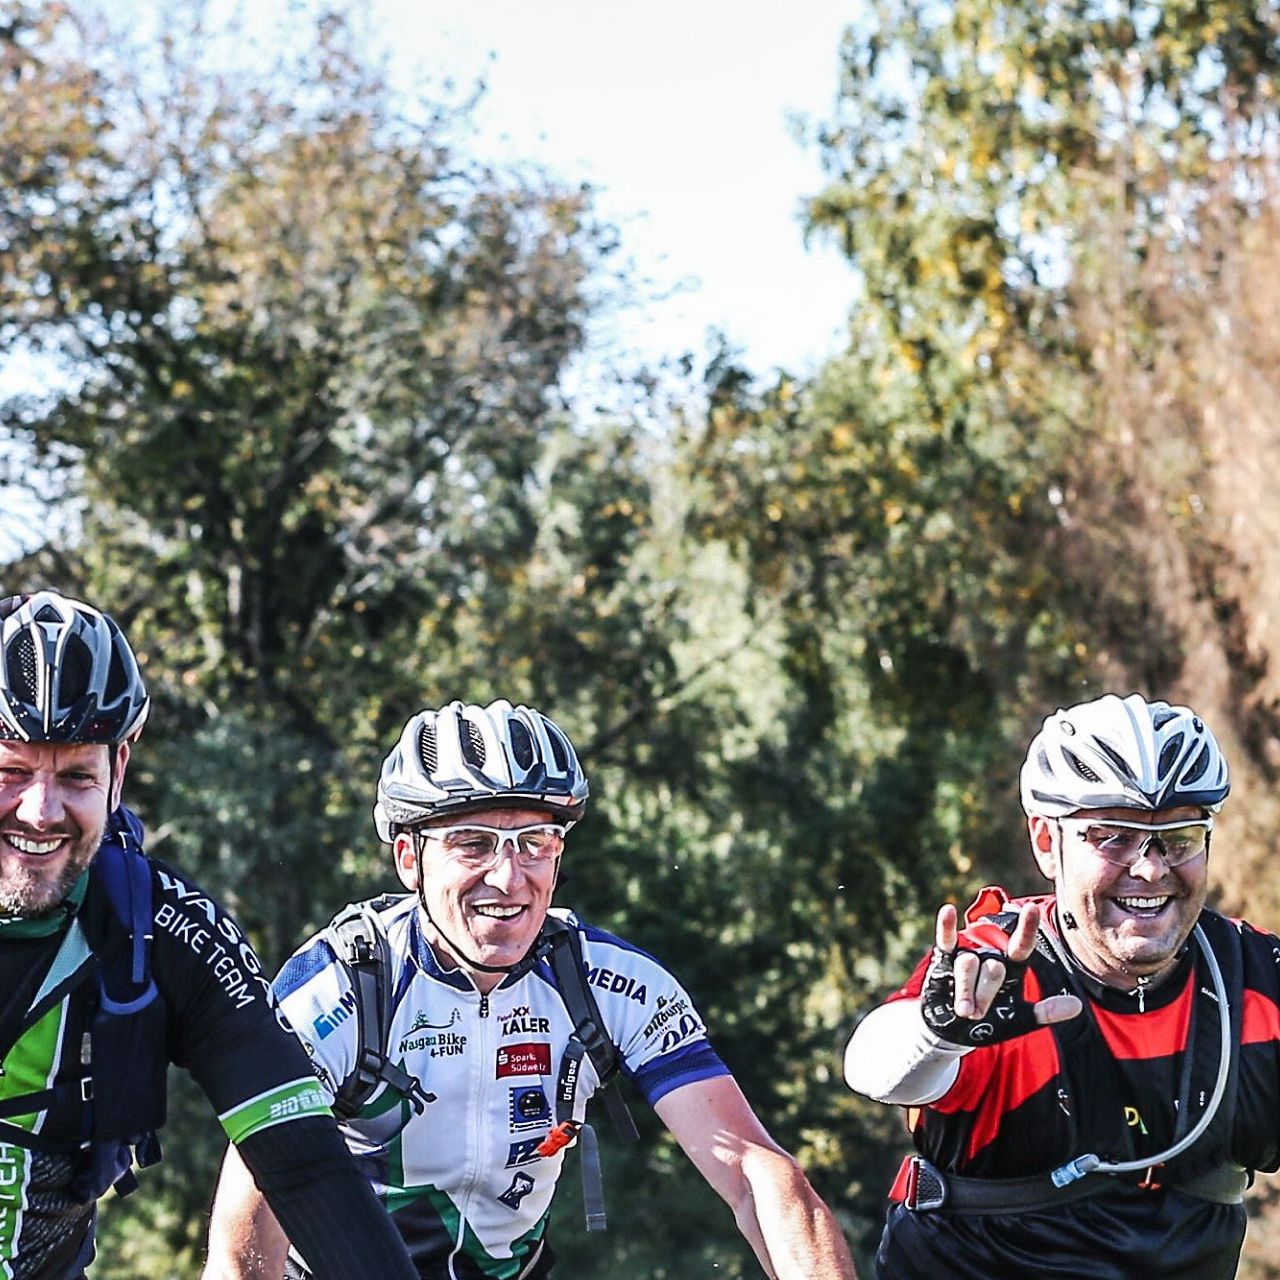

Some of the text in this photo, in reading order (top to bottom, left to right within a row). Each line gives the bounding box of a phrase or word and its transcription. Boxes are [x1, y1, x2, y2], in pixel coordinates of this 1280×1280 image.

[154, 903, 256, 1010] BIKE TEAM
[157, 870, 294, 1033] WASGAU
[438, 1033, 467, 1047] Bike
